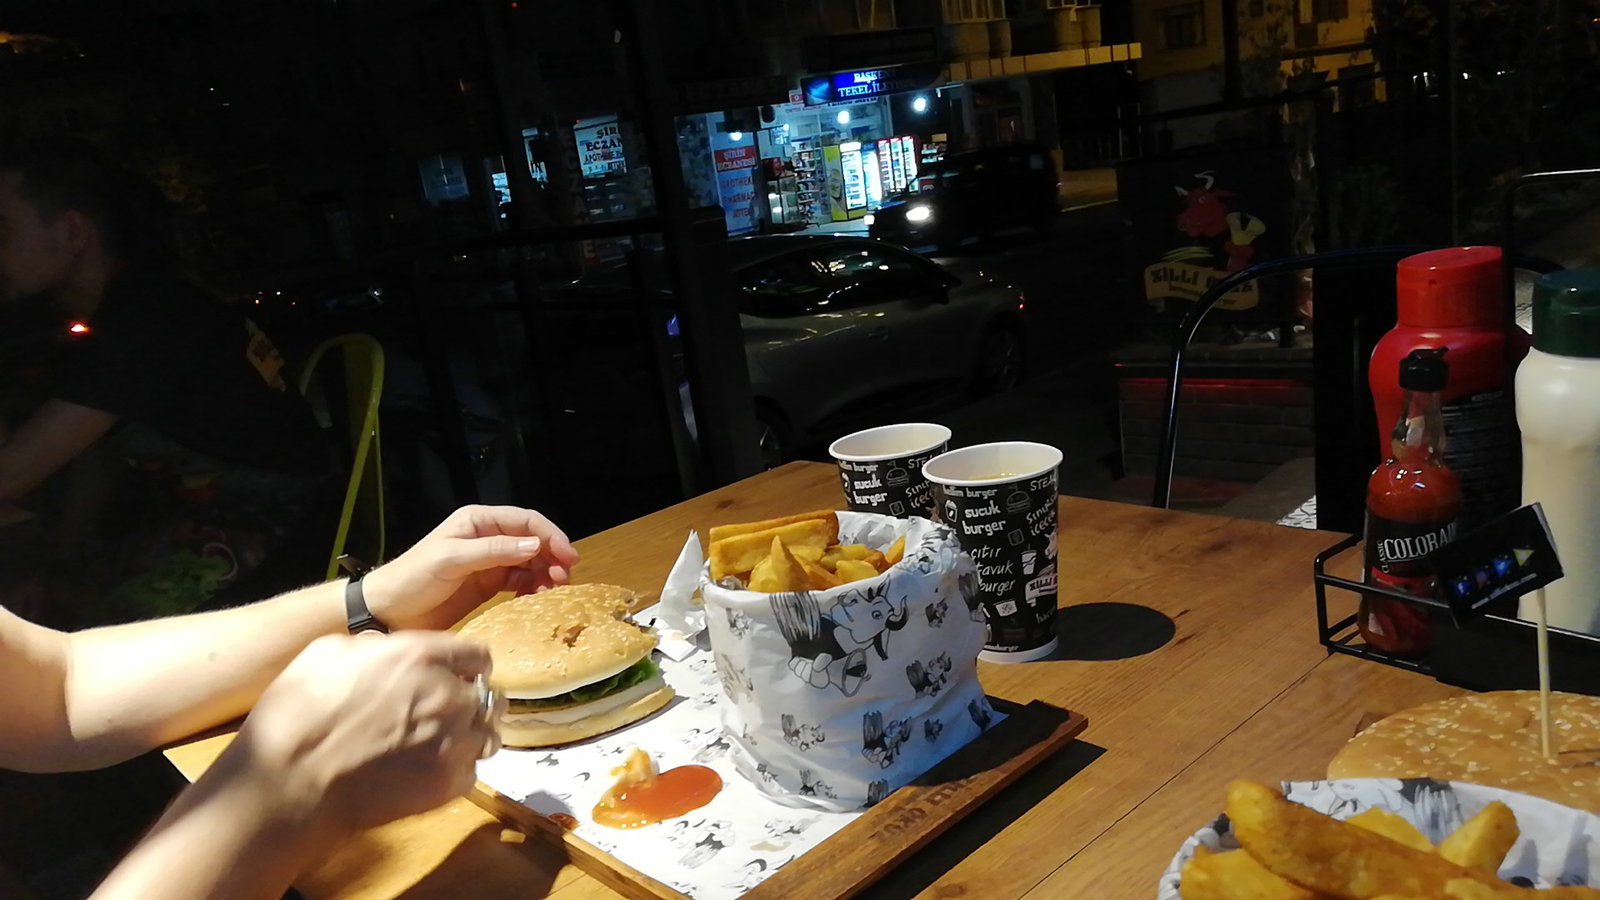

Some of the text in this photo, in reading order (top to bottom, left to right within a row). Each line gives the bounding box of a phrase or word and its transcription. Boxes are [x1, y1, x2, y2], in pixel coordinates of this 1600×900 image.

[838, 84, 871, 97] TEKEL
[852, 462, 879, 474] burger
[853, 473, 883, 490] sucuk
[852, 491, 888, 507] burger
[965, 487, 998, 500] burger
[964, 499, 1001, 519] sucuk
[962, 518, 1007, 537] burger
[976, 560, 1014, 576] tavuk
[979, 578, 1016, 597] burger
